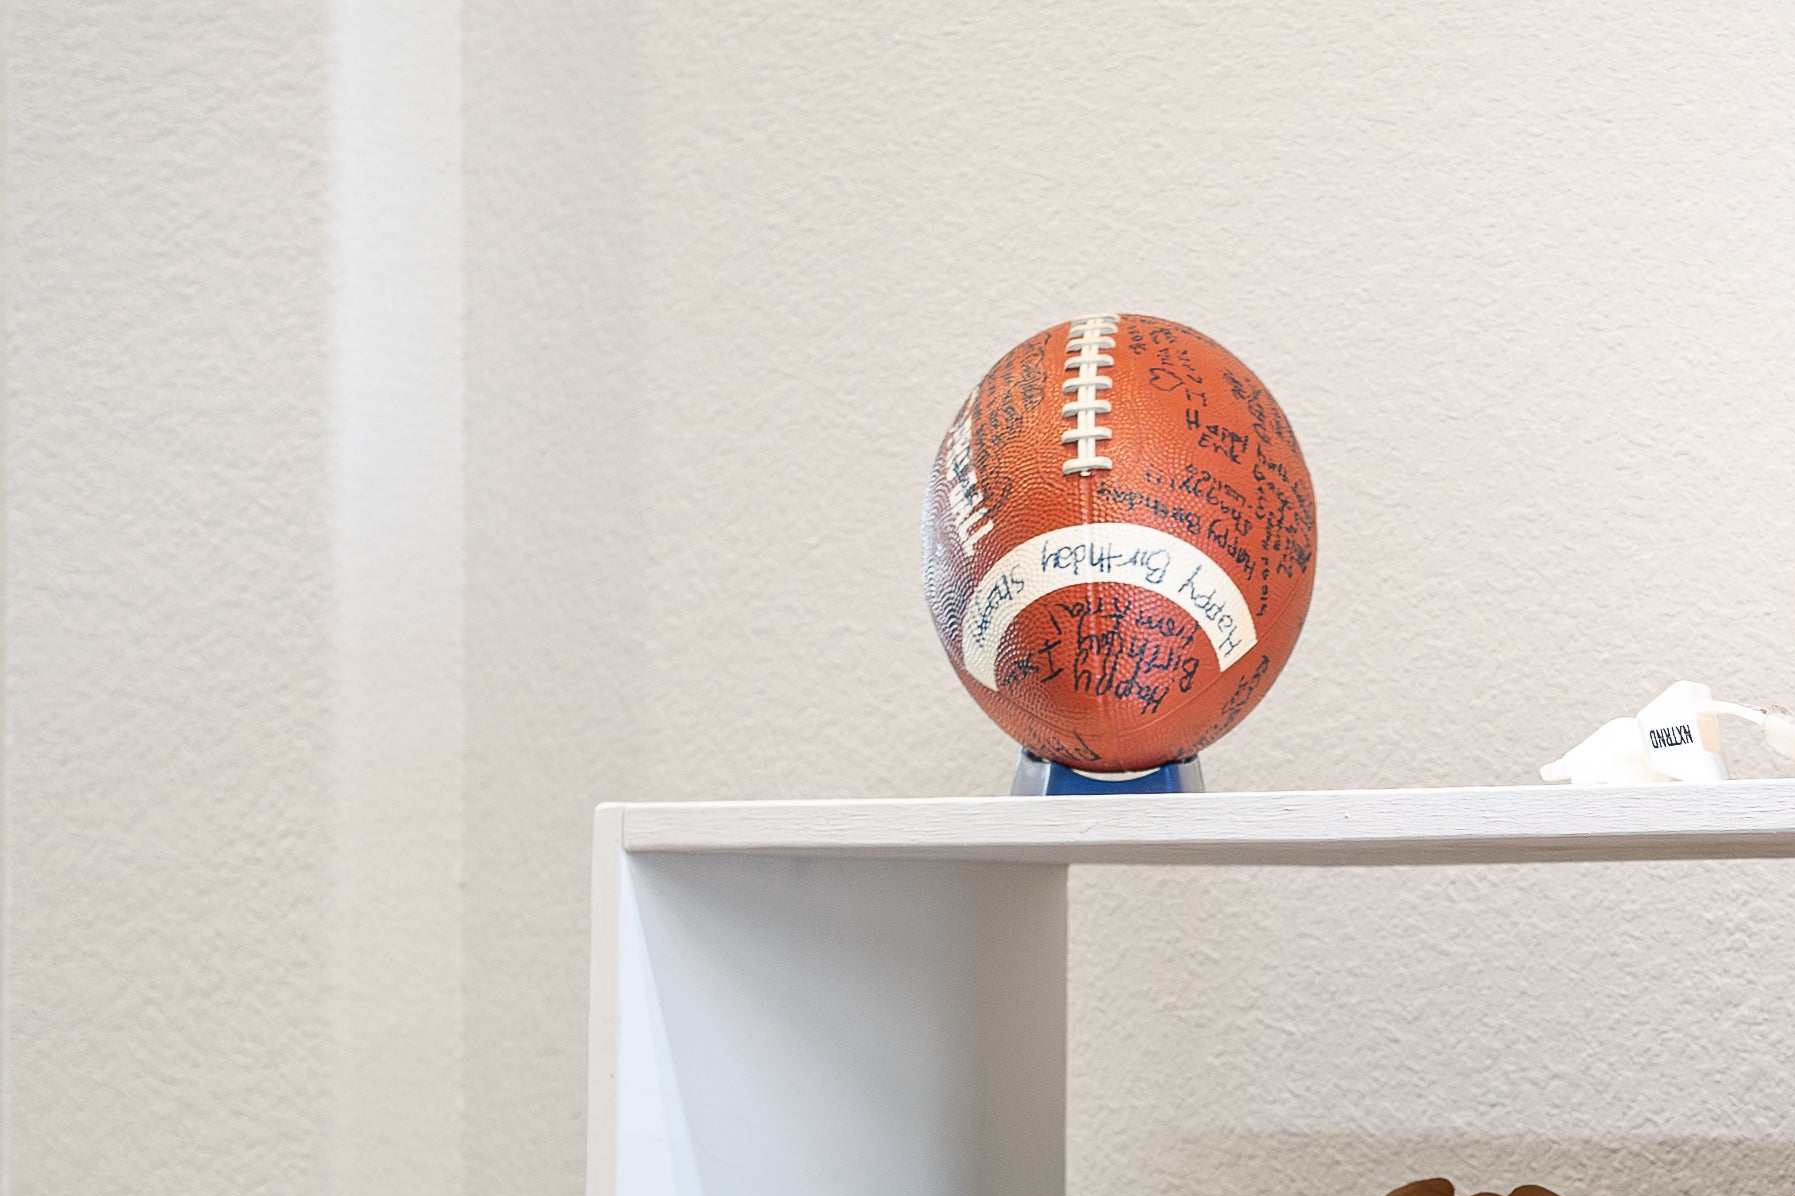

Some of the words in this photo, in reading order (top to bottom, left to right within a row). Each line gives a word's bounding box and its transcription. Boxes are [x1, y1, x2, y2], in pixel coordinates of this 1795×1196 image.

[1041, 540, 1171, 584] Birthday
[1179, 565, 1242, 658] Happy
[1074, 648, 1170, 715] Happy
[1077, 612, 1200, 693] Birthday
[1649, 724, 1694, 749] NXTRND
